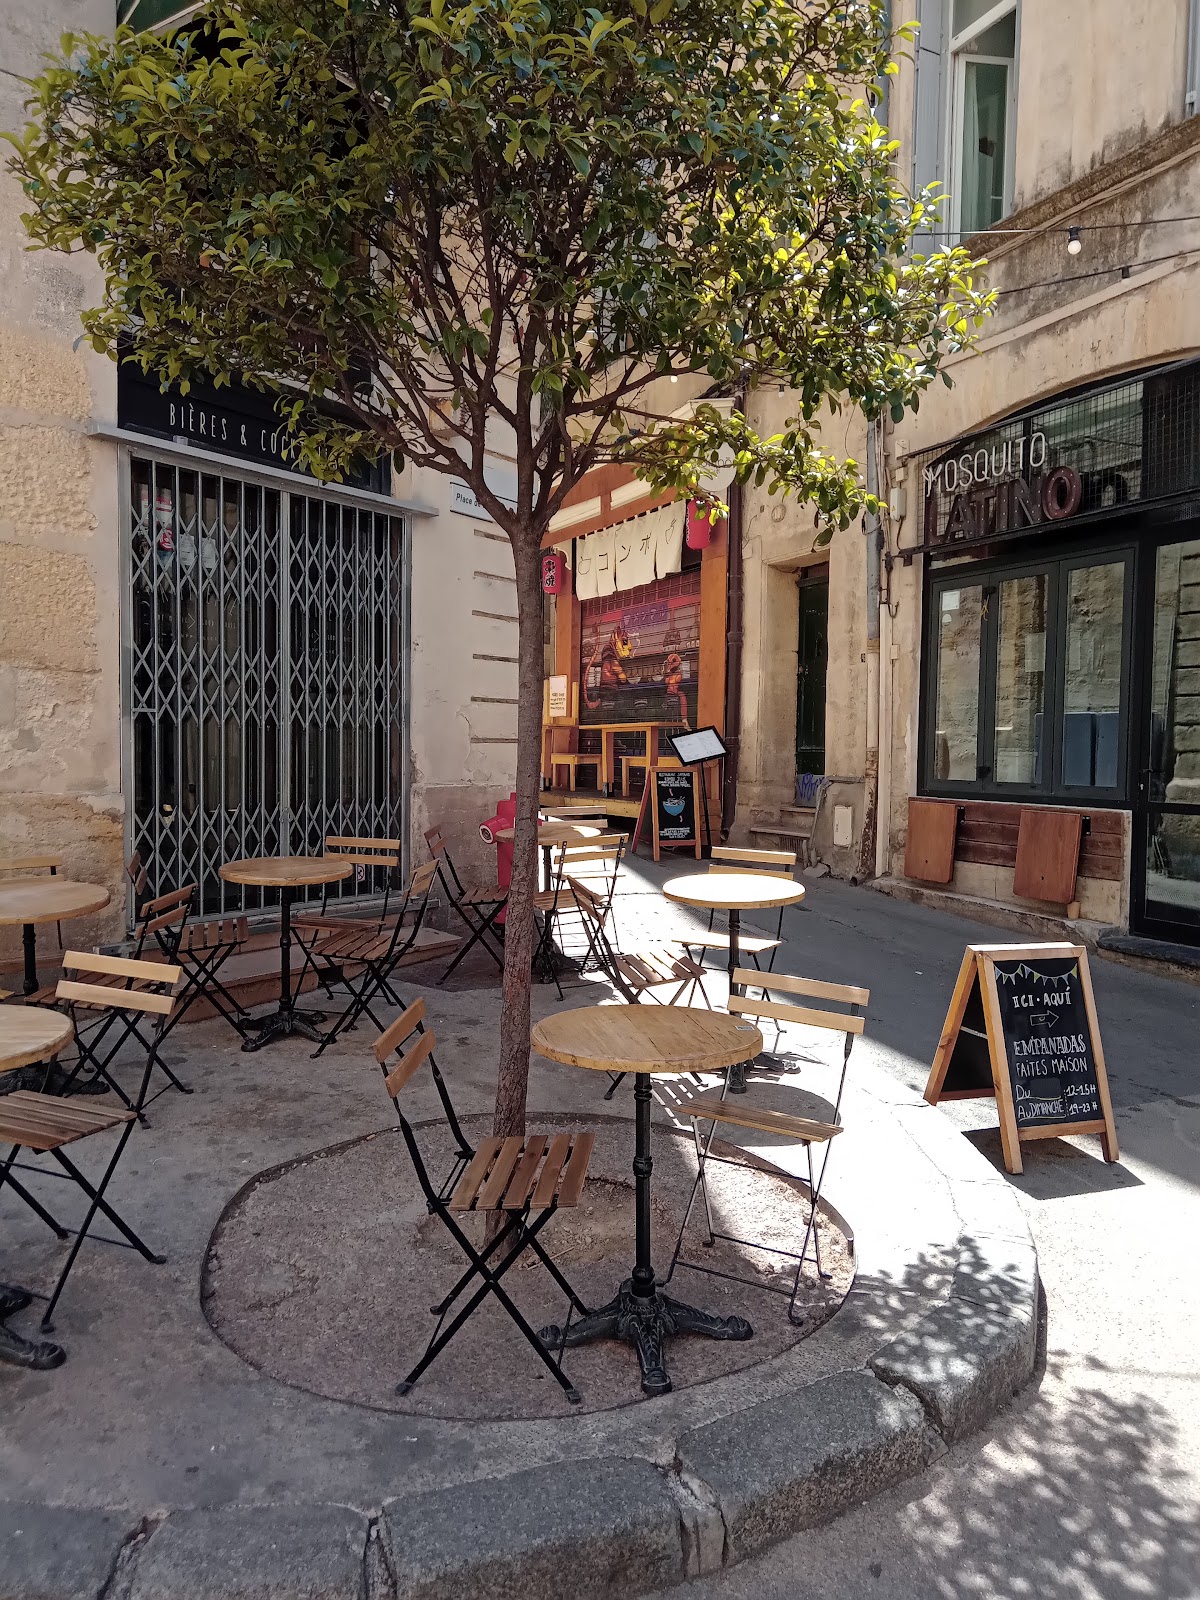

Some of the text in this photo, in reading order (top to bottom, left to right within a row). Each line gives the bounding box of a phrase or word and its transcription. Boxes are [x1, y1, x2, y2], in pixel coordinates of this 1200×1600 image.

[169, 402, 227, 441] BIÈRES
[240, 424, 247, 446] &
[921, 432, 1046, 497] MOSQUITO
[455, 492, 473, 505] Place
[925, 466, 1082, 546] LATINO
[1012, 986, 1072, 1008] ICI AQUÍ
[1013, 1033, 1086, 1056] EMPANADAS
